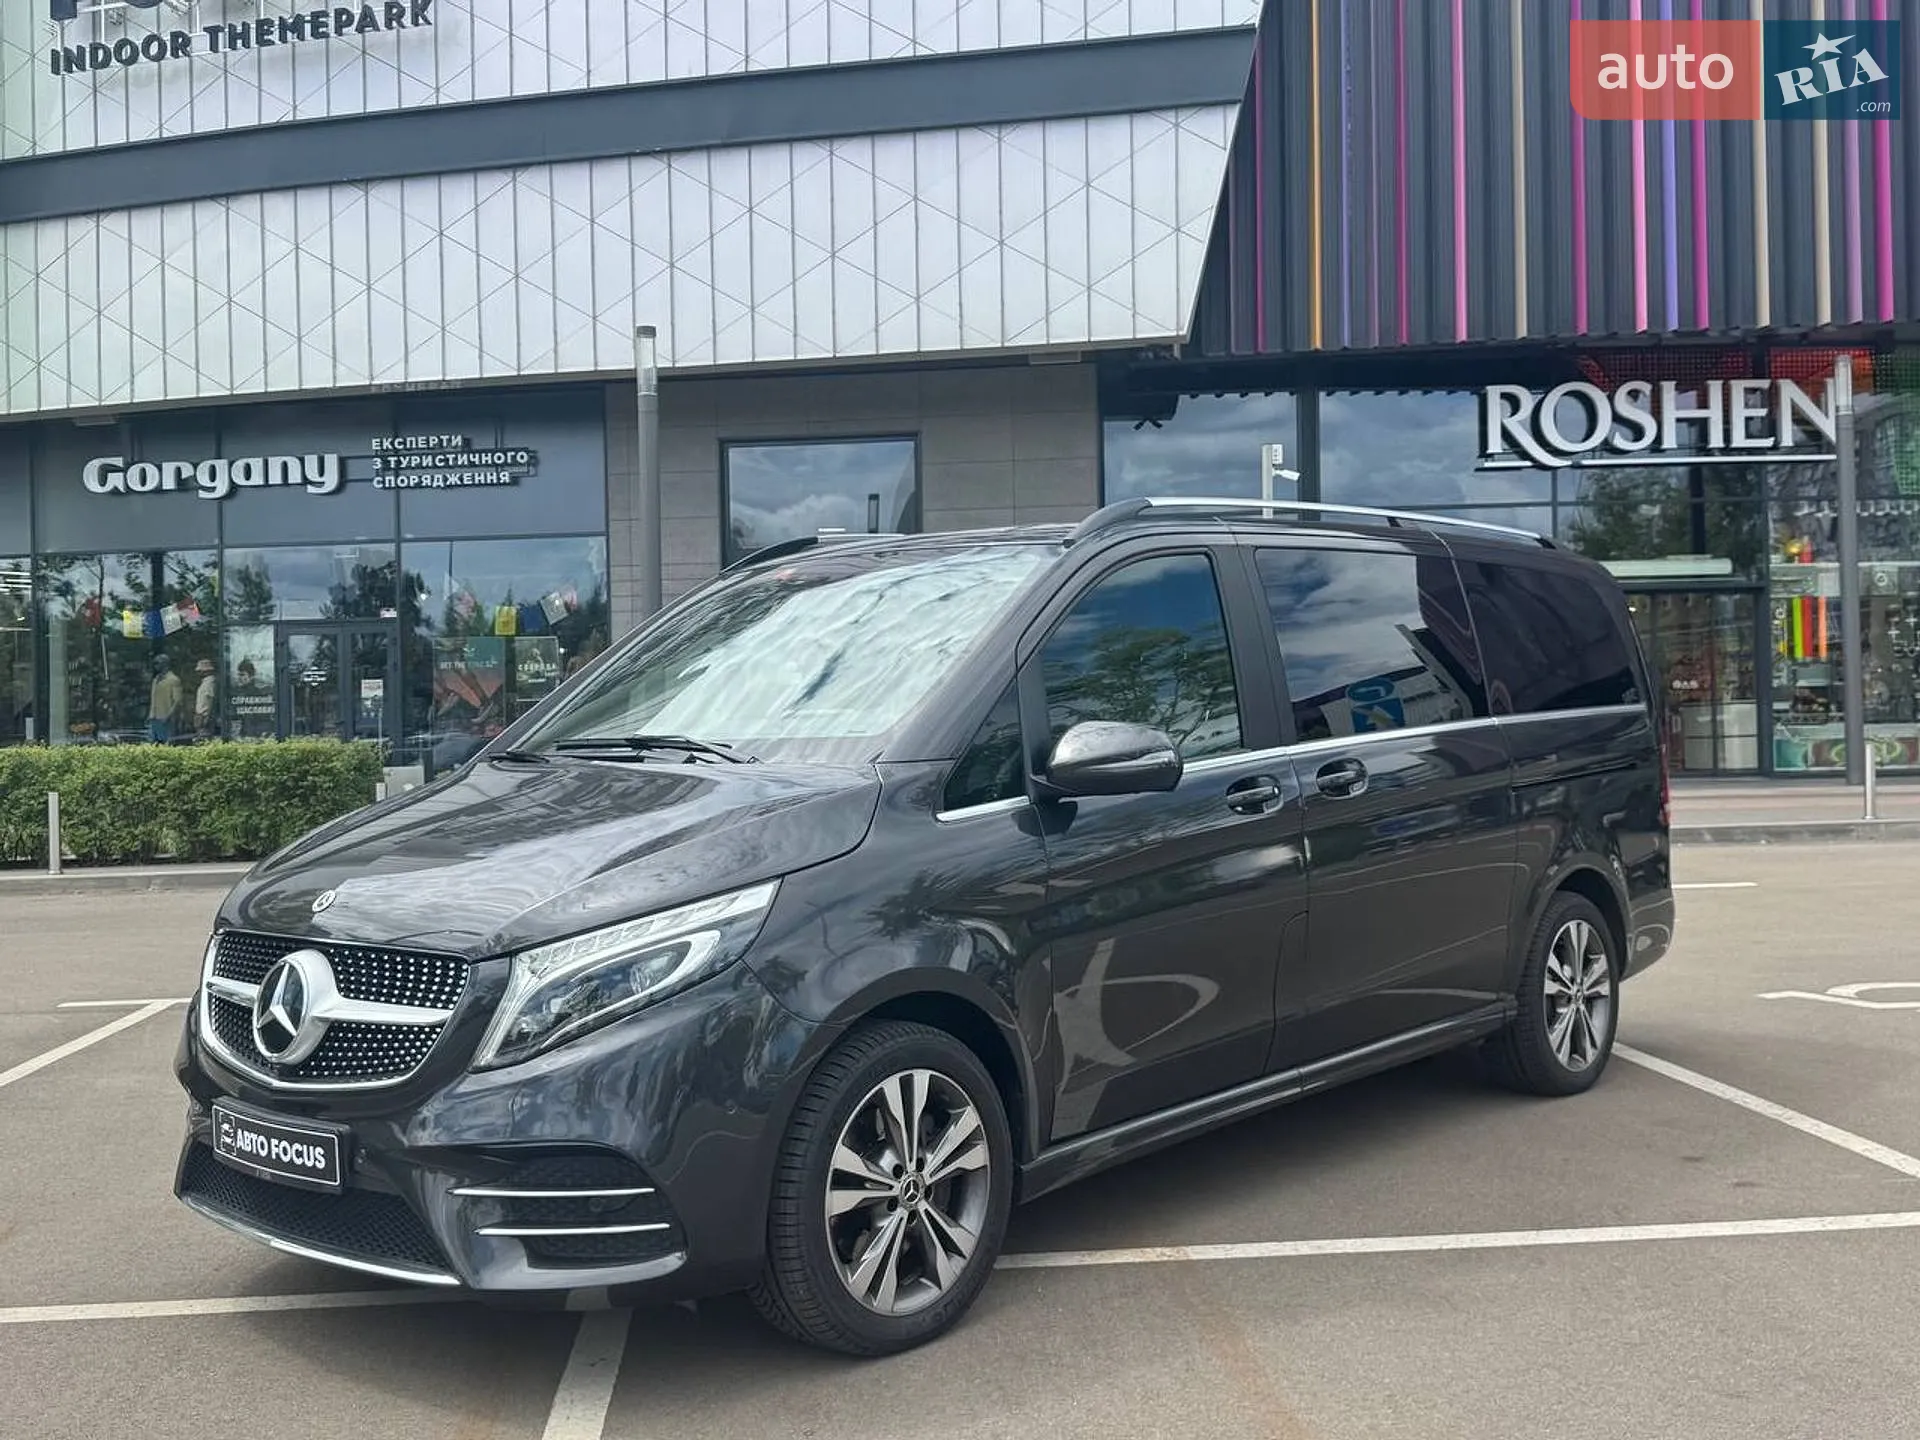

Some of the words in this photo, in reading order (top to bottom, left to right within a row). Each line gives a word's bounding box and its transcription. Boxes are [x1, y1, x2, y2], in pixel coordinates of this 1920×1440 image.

[50, 29, 193, 76] INDOOR
[202, 0, 433, 53] THEMEPARK
[1485, 380, 1838, 467] ROSHEN
[371, 434, 463, 451] ЕКСПЕРТИ
[387, 450, 530, 469] ТУРИСТИЧНОГО
[82, 453, 340, 500] Gorgany
[372, 471, 511, 488] СПОРЯДЖЕННЯ
[270, 1137, 326, 1170] FOCUS
